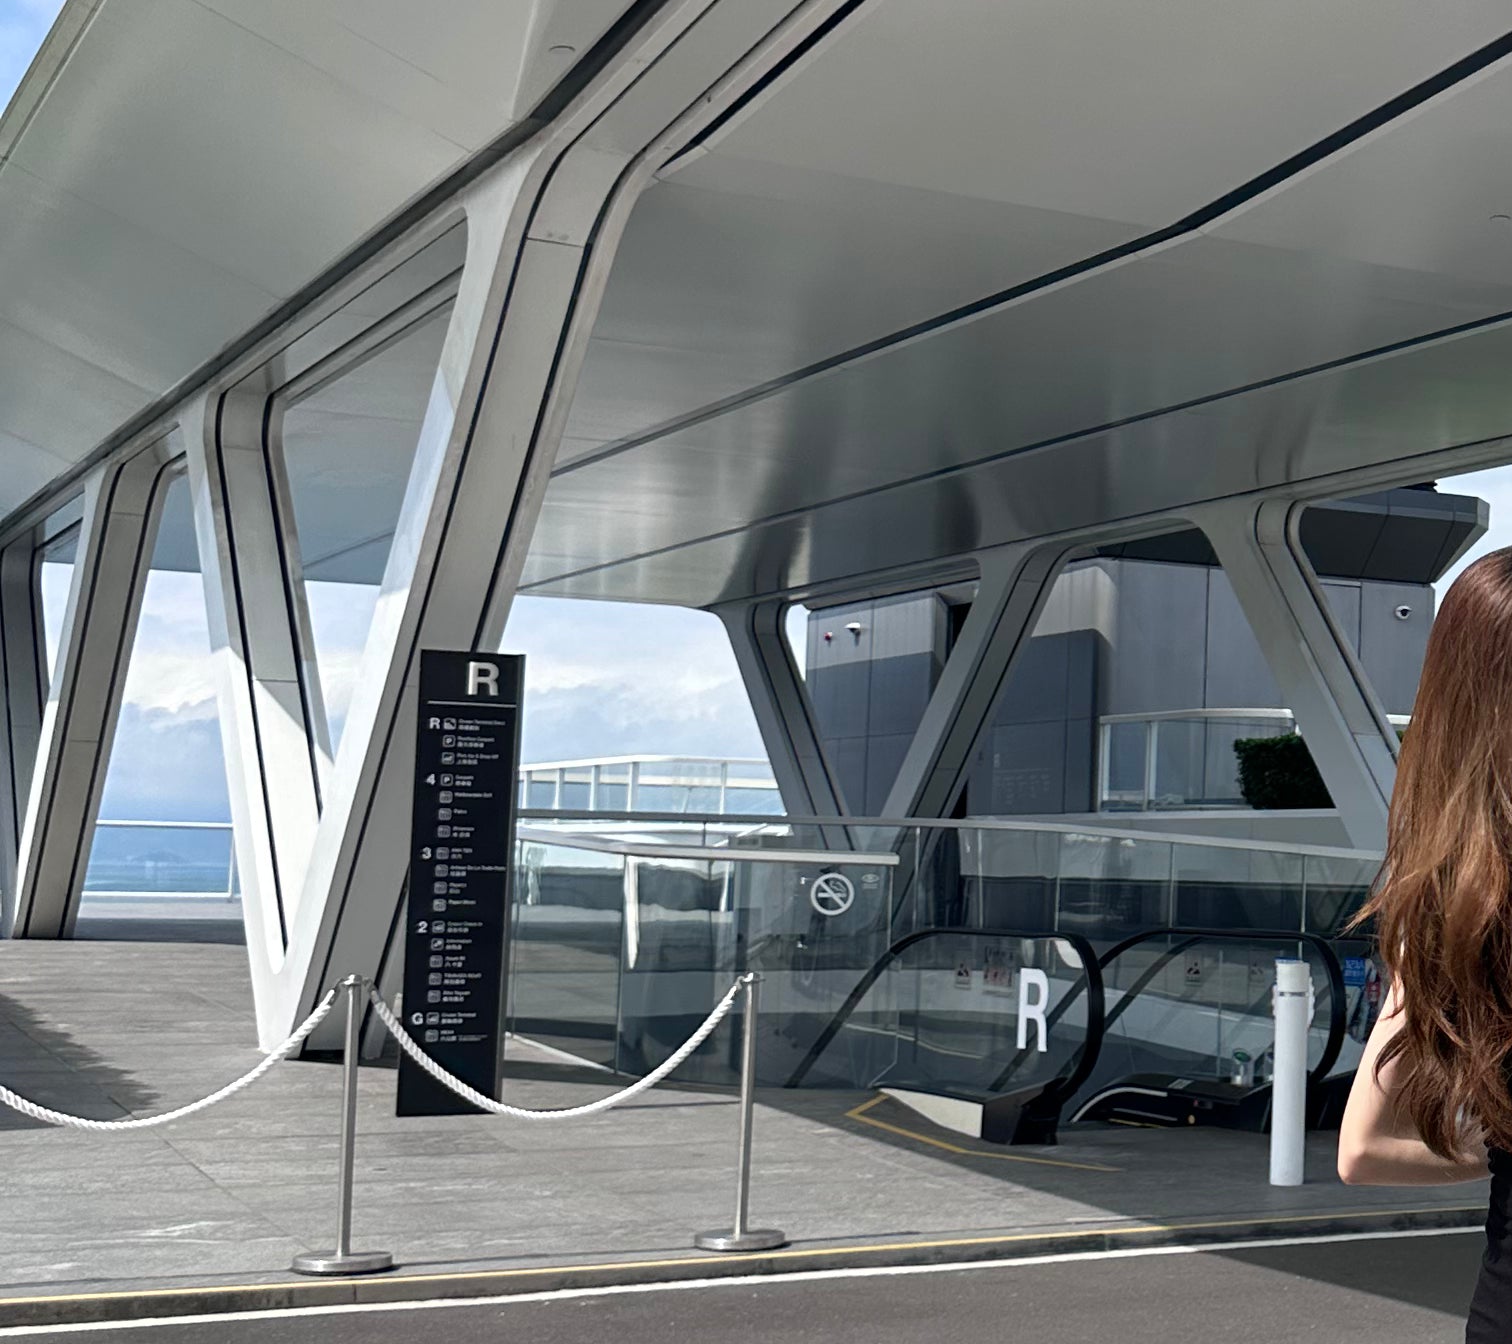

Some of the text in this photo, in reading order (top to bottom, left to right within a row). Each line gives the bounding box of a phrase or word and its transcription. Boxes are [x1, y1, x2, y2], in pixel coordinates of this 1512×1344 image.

[468, 661, 500, 696] R
[429, 717, 441, 729] R
[425, 773, 436, 786] 4
[421, 846, 432, 860] 3
[416, 920, 428, 934] 2
[1017, 968, 1049, 1052] R
[411, 1011, 423, 1025] G
